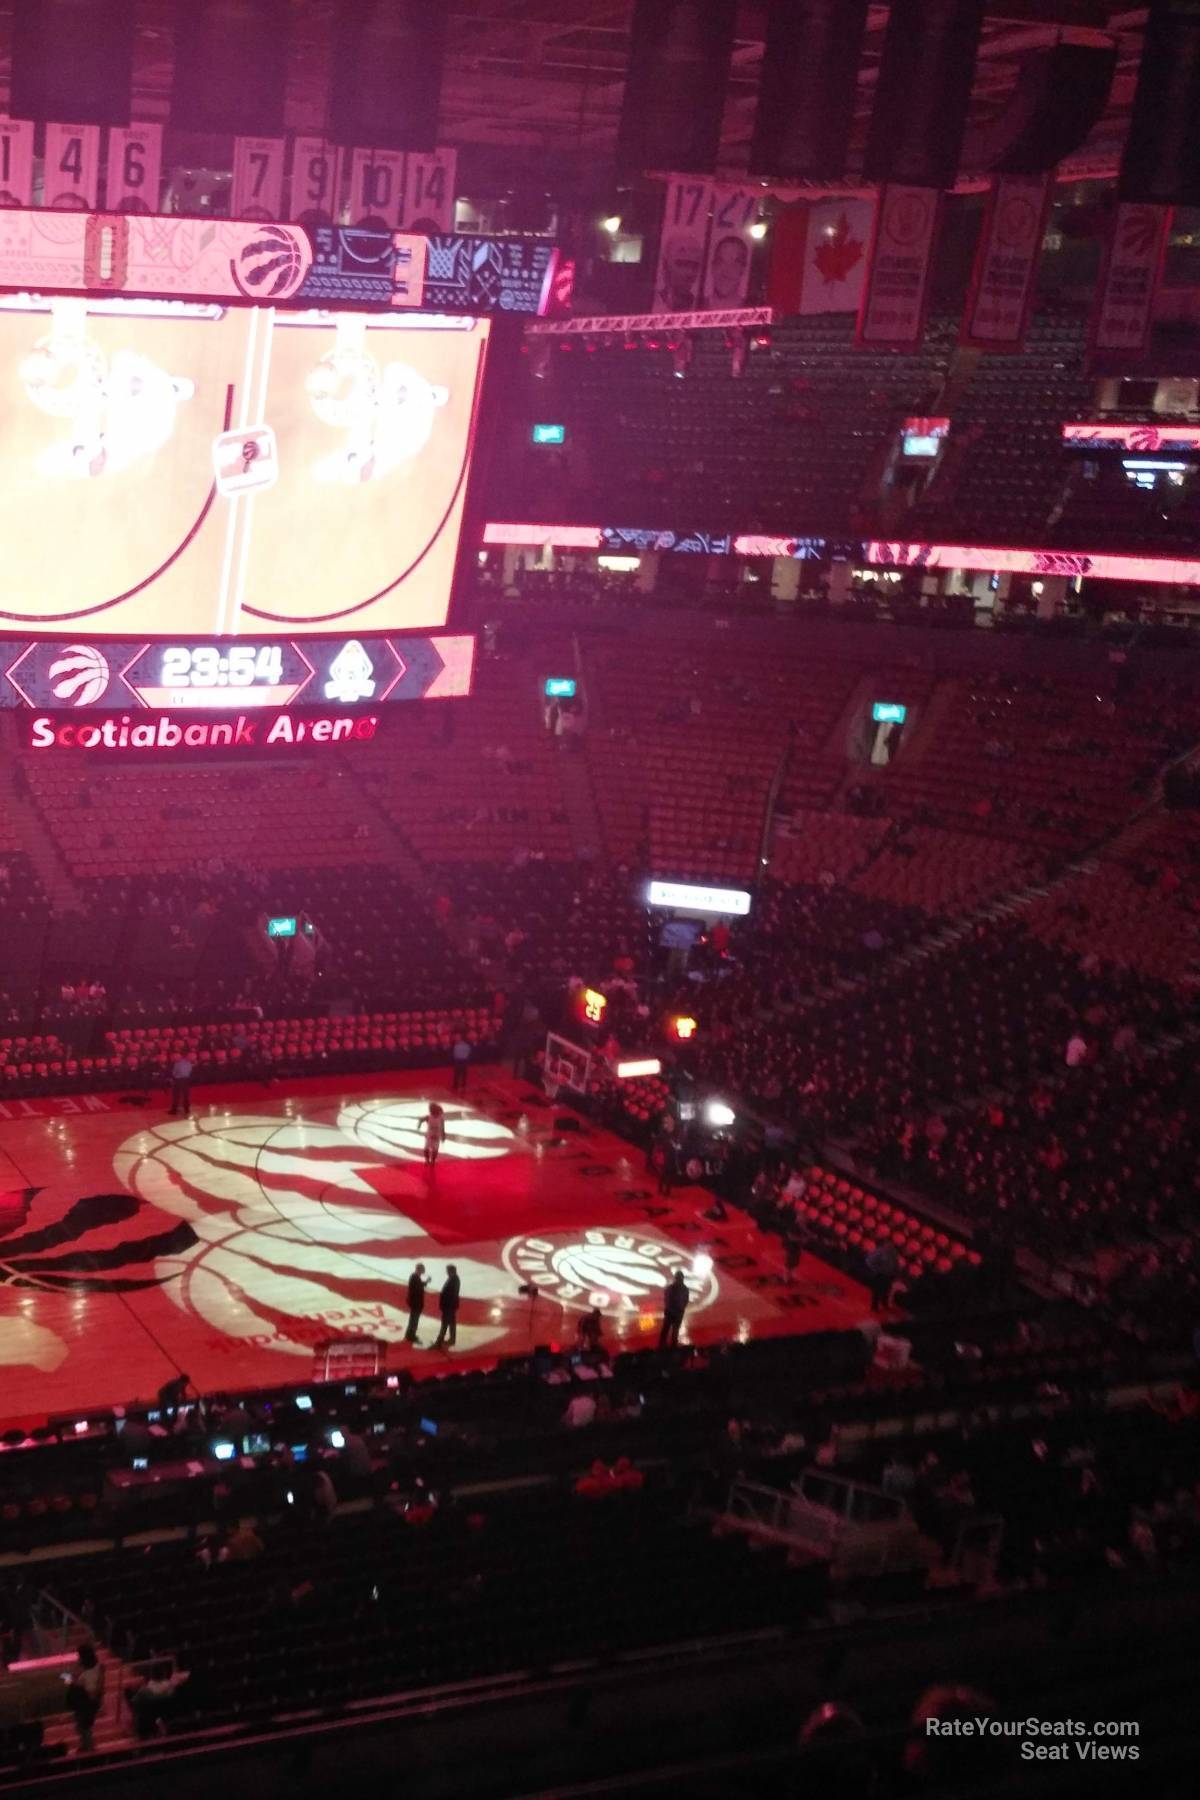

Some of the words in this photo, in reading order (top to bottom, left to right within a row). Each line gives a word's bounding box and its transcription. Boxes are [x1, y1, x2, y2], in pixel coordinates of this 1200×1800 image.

[1, 135, 11, 182] 1
[58, 138, 83, 185] 4
[123, 142, 146, 189] 6
[249, 152, 270, 198] 7
[307, 157, 329, 200] 9
[361, 163, 393, 209] 10
[415, 165, 447, 210] 14
[162, 645, 284, 687] 23:54
[31, 716, 254, 748] Scotiabank
[266, 714, 379, 744] Arena
[53, 1093, 111, 1115] WE
[516, 1238, 640, 1312] TORONTO
